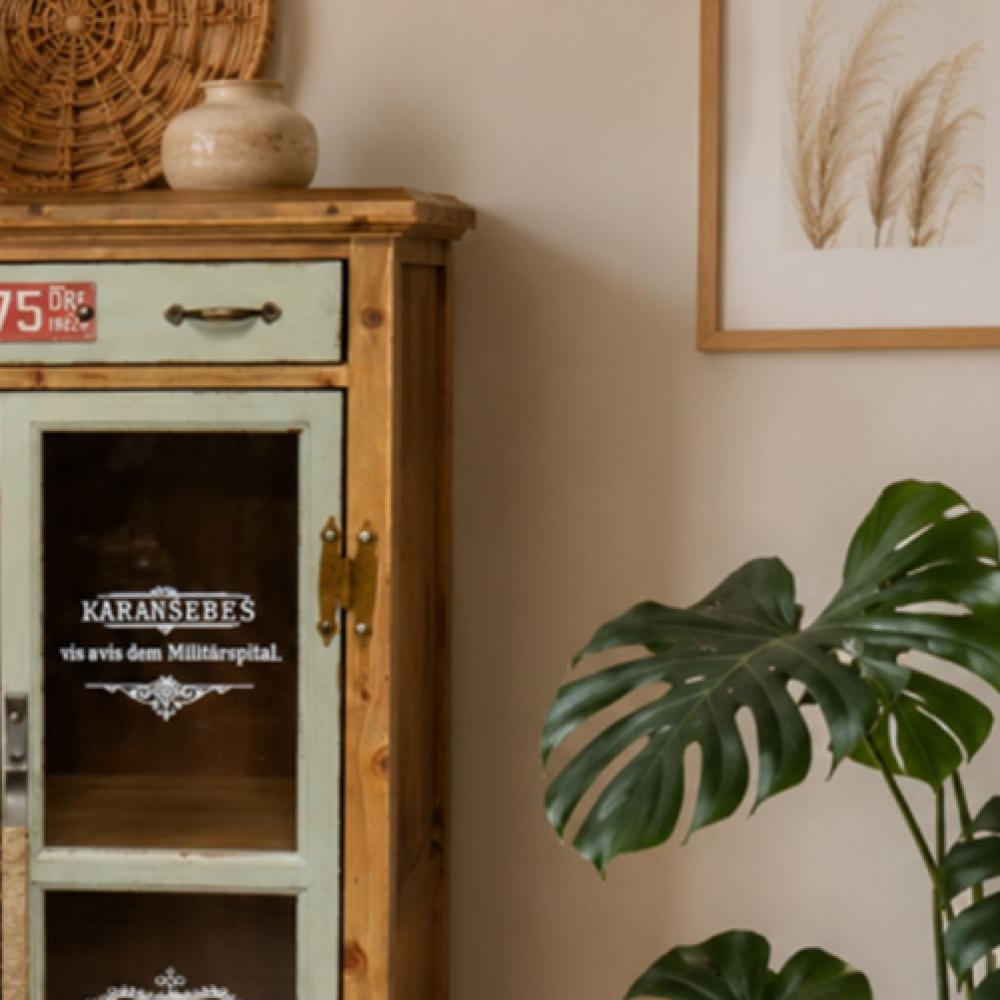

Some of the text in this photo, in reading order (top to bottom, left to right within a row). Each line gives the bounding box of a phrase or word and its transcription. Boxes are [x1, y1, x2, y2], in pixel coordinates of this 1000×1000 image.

[81, 599, 256, 623] KARANSEBES
[60, 642, 84, 662] vis
[126, 642, 162, 662] dem
